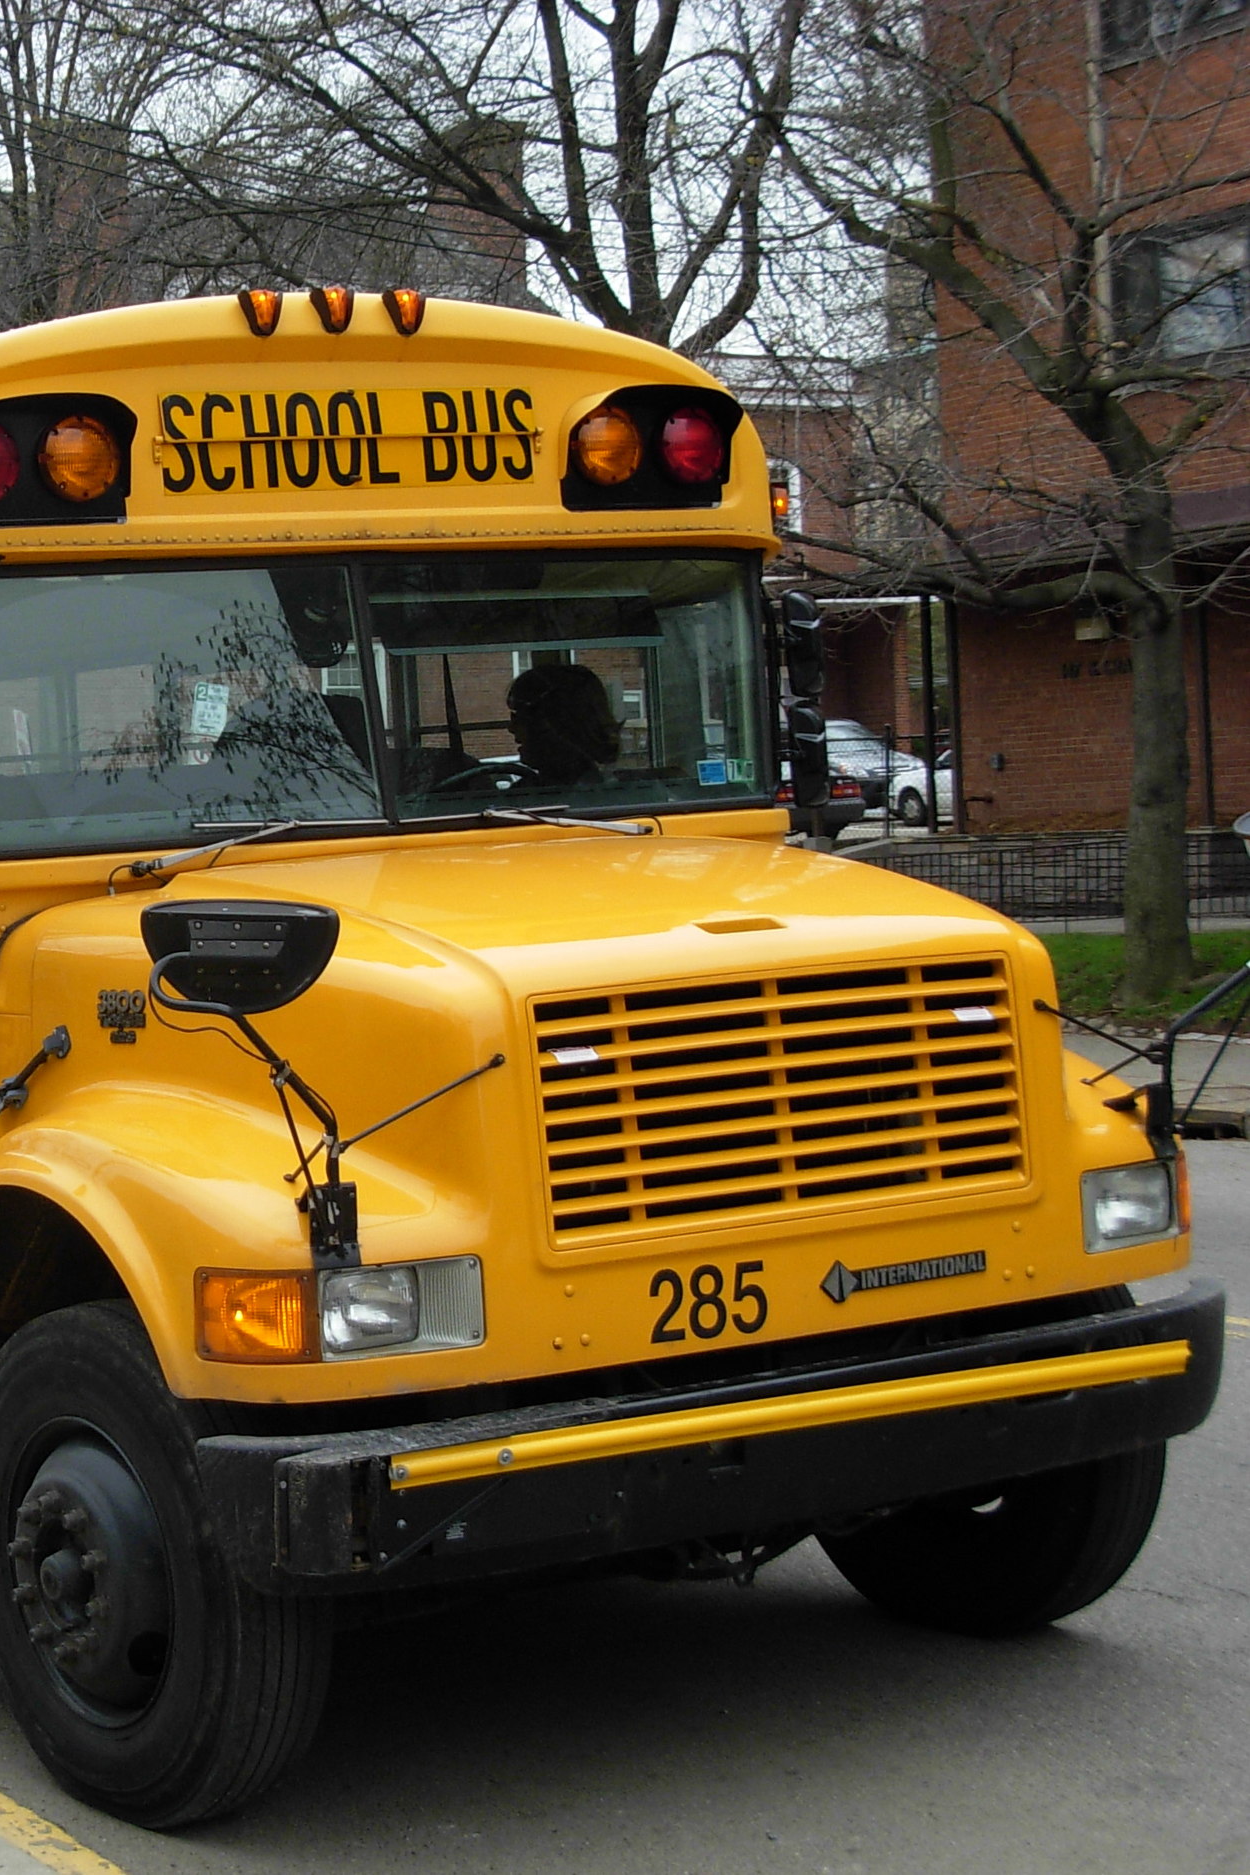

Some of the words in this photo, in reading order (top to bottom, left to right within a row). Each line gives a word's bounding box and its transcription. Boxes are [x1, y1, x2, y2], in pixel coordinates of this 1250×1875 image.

[161, 391, 400, 493] SCHOOL
[421, 388, 534, 483] BUS
[97, 989, 146, 1013] 3800
[649, 1259, 768, 1344] 285
[860, 1252, 986, 1290] INTERNATIONAL
